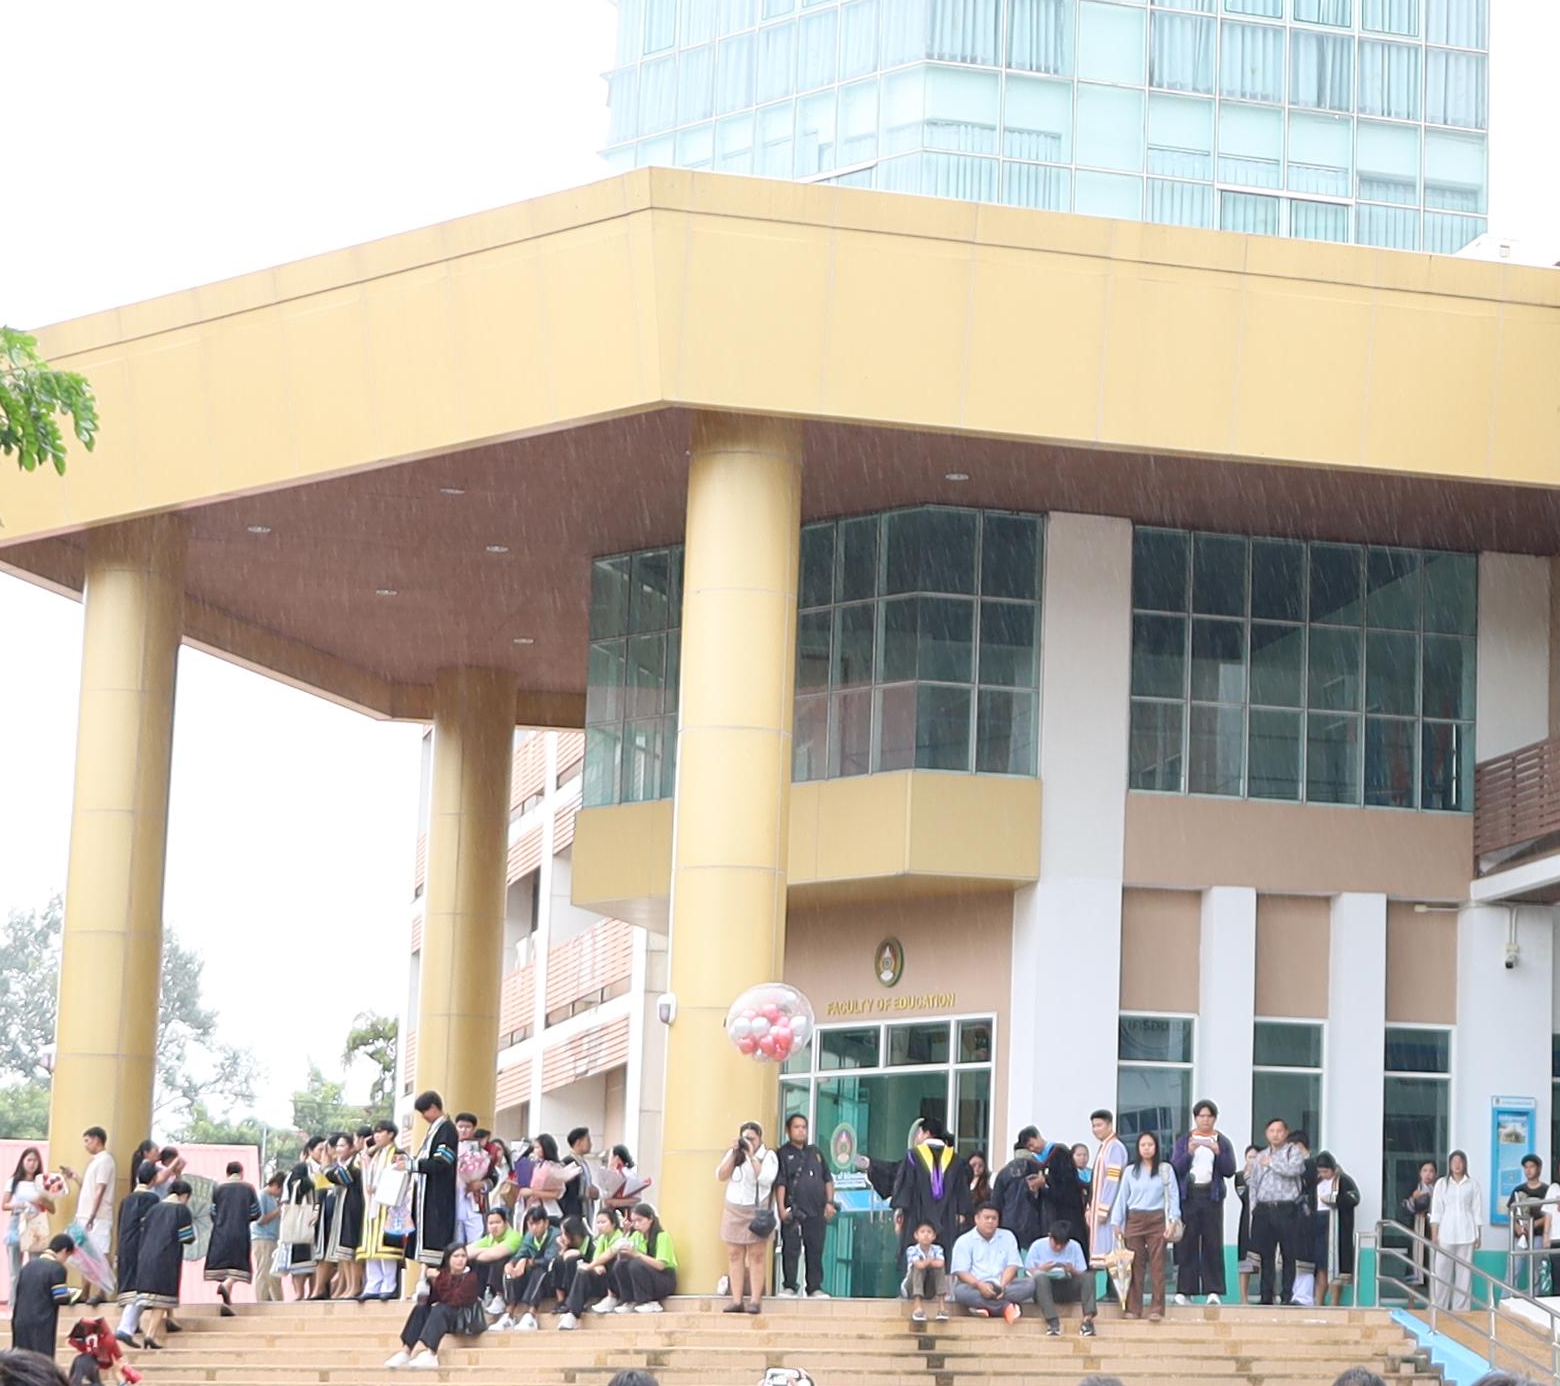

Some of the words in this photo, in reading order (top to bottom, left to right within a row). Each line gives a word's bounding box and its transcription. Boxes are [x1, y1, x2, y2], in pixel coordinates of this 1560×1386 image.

[827, 999, 873, 1015] FACULTY
[876, 997, 891, 1012] OF
[894, 992, 956, 1011] EDUCATION
